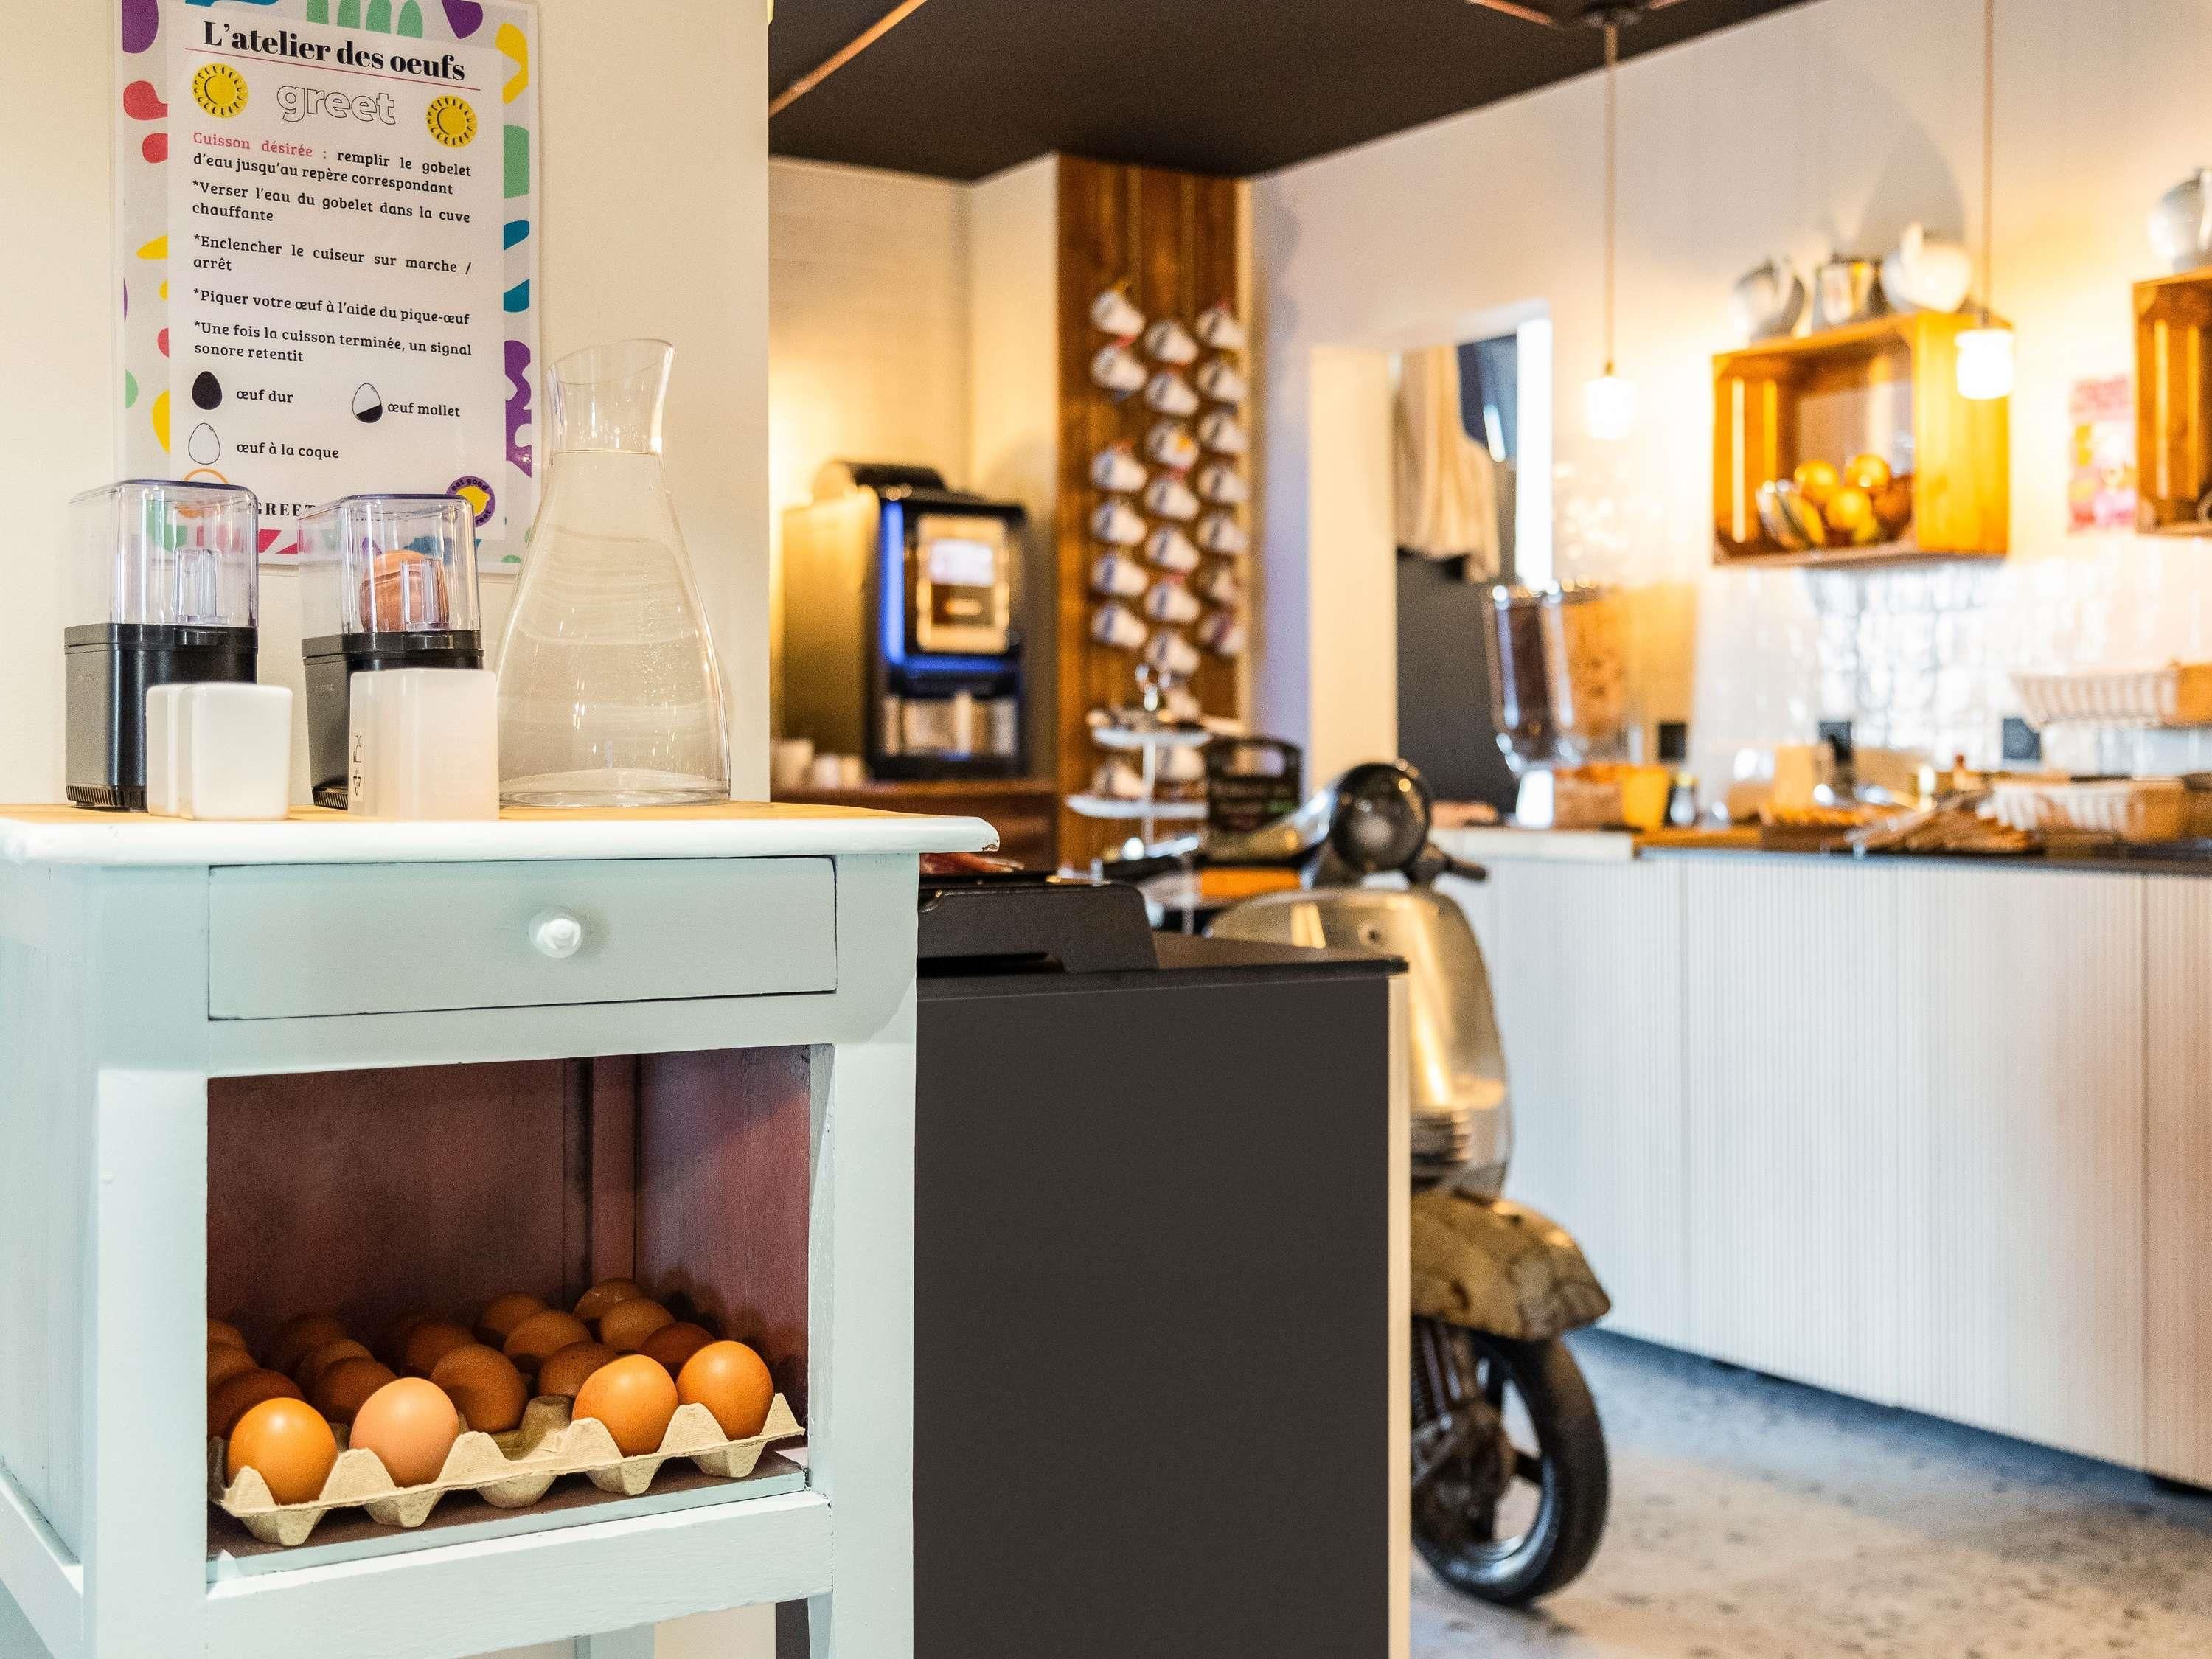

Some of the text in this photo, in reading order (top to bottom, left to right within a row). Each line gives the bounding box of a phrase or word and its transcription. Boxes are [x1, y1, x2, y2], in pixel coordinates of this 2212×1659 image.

[203, 19, 466, 82] L’atelier des oeufs
[276, 85, 397, 125] greet
[192, 131, 251, 150] Cuisson
[261, 139, 313, 158] désirée
[336, 152, 390, 168] remplir
[400, 156, 412, 170] le
[422, 161, 472, 177] gobelet
[193, 153, 453, 195] d’eau jusqu’au repère correspondant
[192, 202, 274, 222] chauffante
[255, 187, 291, 204] l’eau
[297, 192, 316, 206] du
[321, 196, 374, 212] gobelet
[379, 201, 413, 217] dans
[419, 206, 433, 219] la
[439, 211, 470, 223] cuve
[193, 257, 232, 271] arrêt
[291, 243, 305, 257] le
[313, 248, 366, 263] cuiseur
[374, 255, 397, 266] sur
[405, 259, 457, 273] marche
[252, 296, 291, 309] votre
[294, 299, 324, 312] œuf
[326, 299, 335, 312] à
[338, 301, 376, 317] l’aide
[379, 305, 397, 319] du
[400, 308, 470, 325] pique-œuf
[194, 344, 305, 362] sonore retentit
[232, 324, 260, 338] fois
[263, 327, 278, 340] la
[282, 330, 335, 344] cuisson
[338, 335, 406, 352] terminée,
[408, 342, 427, 352] un
[430, 341, 472, 357] signal
[236, 389, 294, 403] œuf dur
[387, 402, 461, 417] œuf mollet
[236, 442, 339, 461] œuf à la coque
[451, 478, 490, 491] eat good
